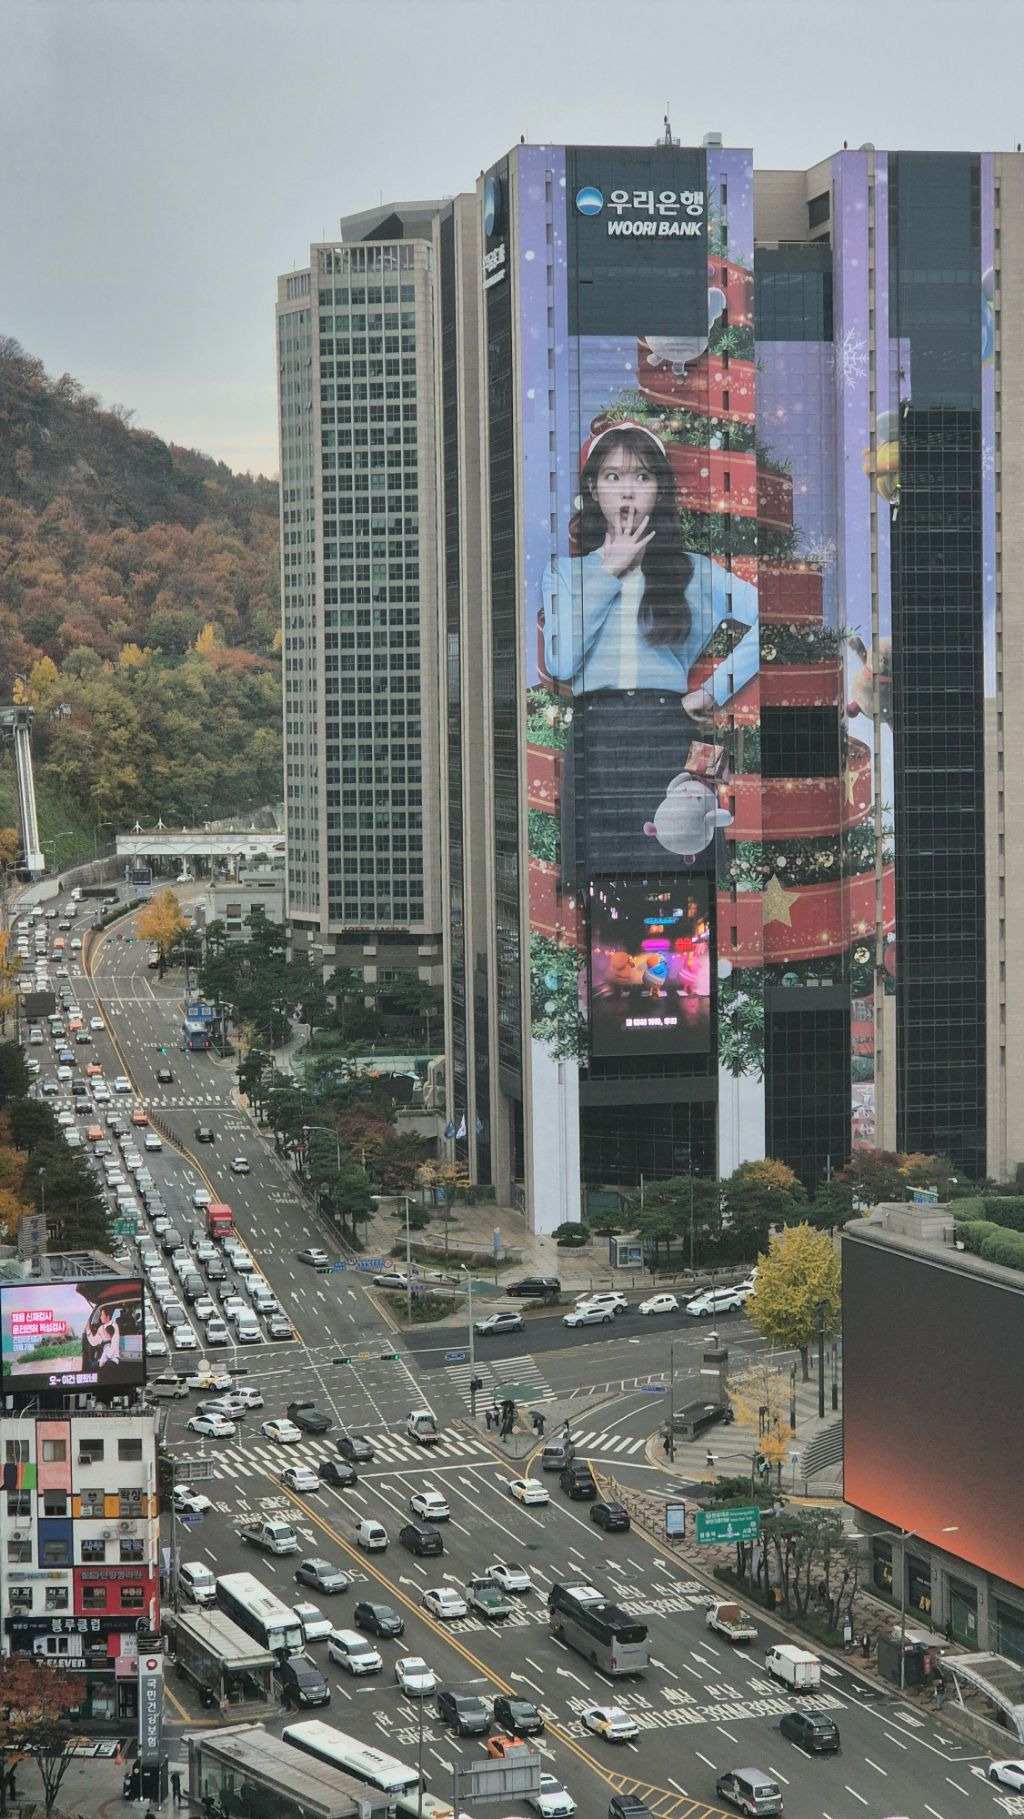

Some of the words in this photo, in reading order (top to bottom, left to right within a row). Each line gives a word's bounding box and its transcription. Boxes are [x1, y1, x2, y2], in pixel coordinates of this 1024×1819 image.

[607, 190, 704, 215] 우리은행
[608, 221, 658, 236] WOORI
[659, 221, 703, 236] BANK
[121, 1490, 141, 1501] 왁싱
[52, 1618, 101, 1632] 블루클럽
[147, 1679, 159, 1747] 국민건강보험
